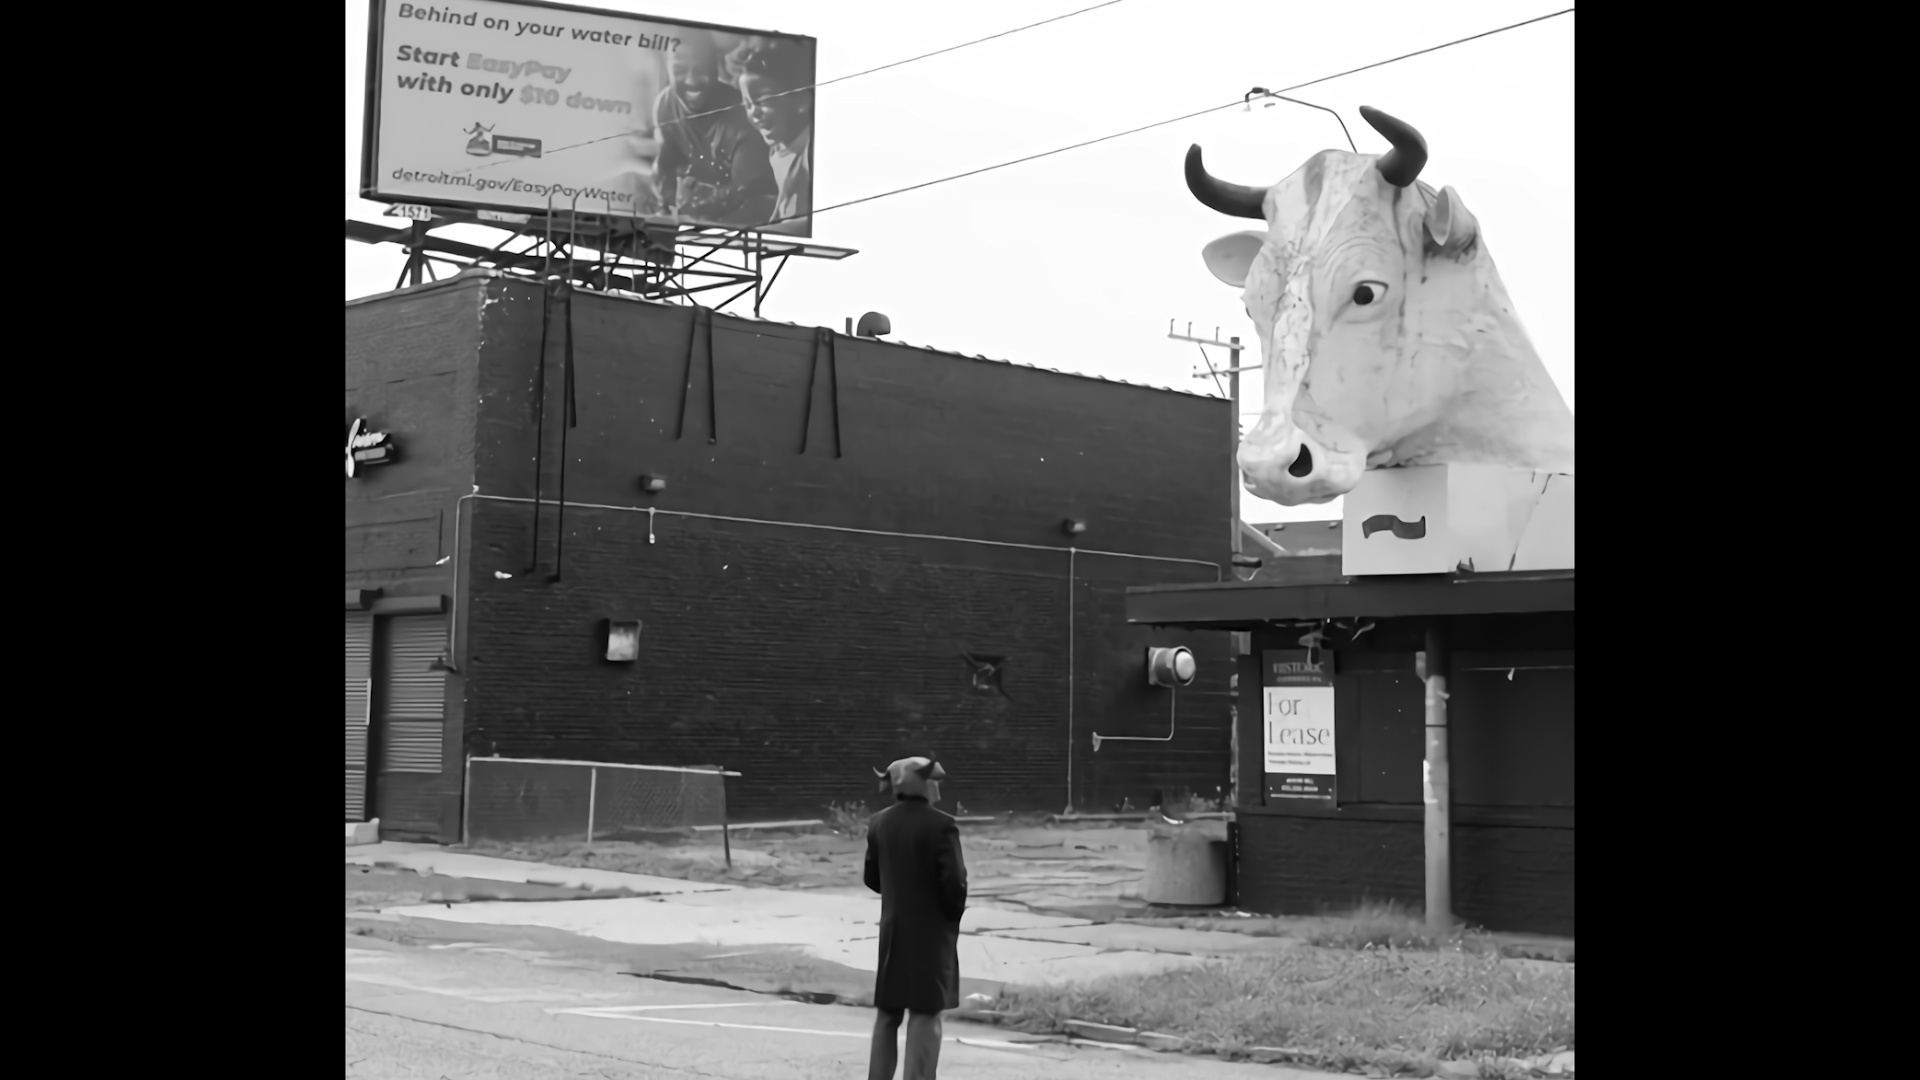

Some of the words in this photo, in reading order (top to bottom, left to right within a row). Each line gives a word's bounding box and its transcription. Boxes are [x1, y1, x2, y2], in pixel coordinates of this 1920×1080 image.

[398, 3, 478, 27] Behind
[483, 17, 510, 31] on
[515, 21, 565, 38] your
[571, 28, 632, 46] water
[638, 33, 681, 52] bill?
[397, 45, 460, 68] Start
[466, 52, 572, 85] EasyPay
[397, 72, 453, 94] with
[460, 82, 514, 104] only
[519, 84, 560, 106] $10
[565, 91, 632, 115] down
[392, 168, 633, 203] detroitmi.gov/EasyPayWater
